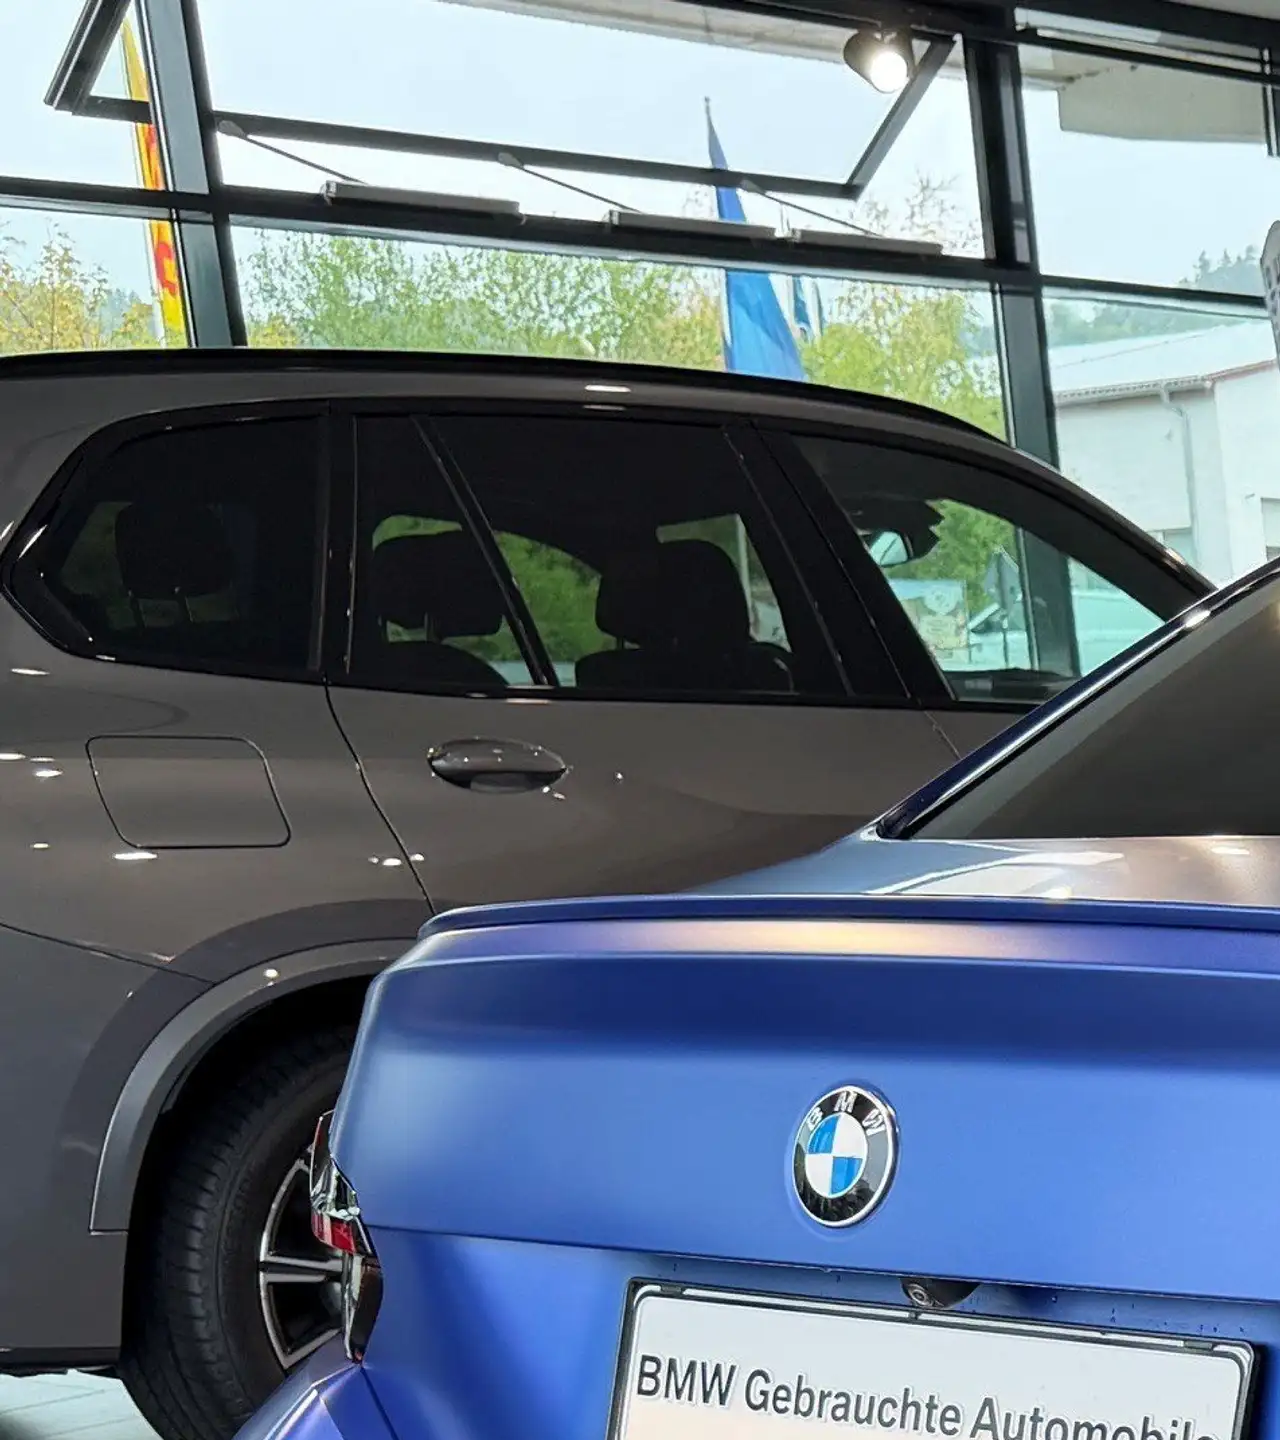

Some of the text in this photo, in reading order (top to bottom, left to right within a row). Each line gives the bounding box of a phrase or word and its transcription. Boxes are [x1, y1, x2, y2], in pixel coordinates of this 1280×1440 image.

[806, 1091, 886, 1136] BMW
[636, 1353, 737, 1407] BMW
[744, 1366, 962, 1440] Gebrauchte
